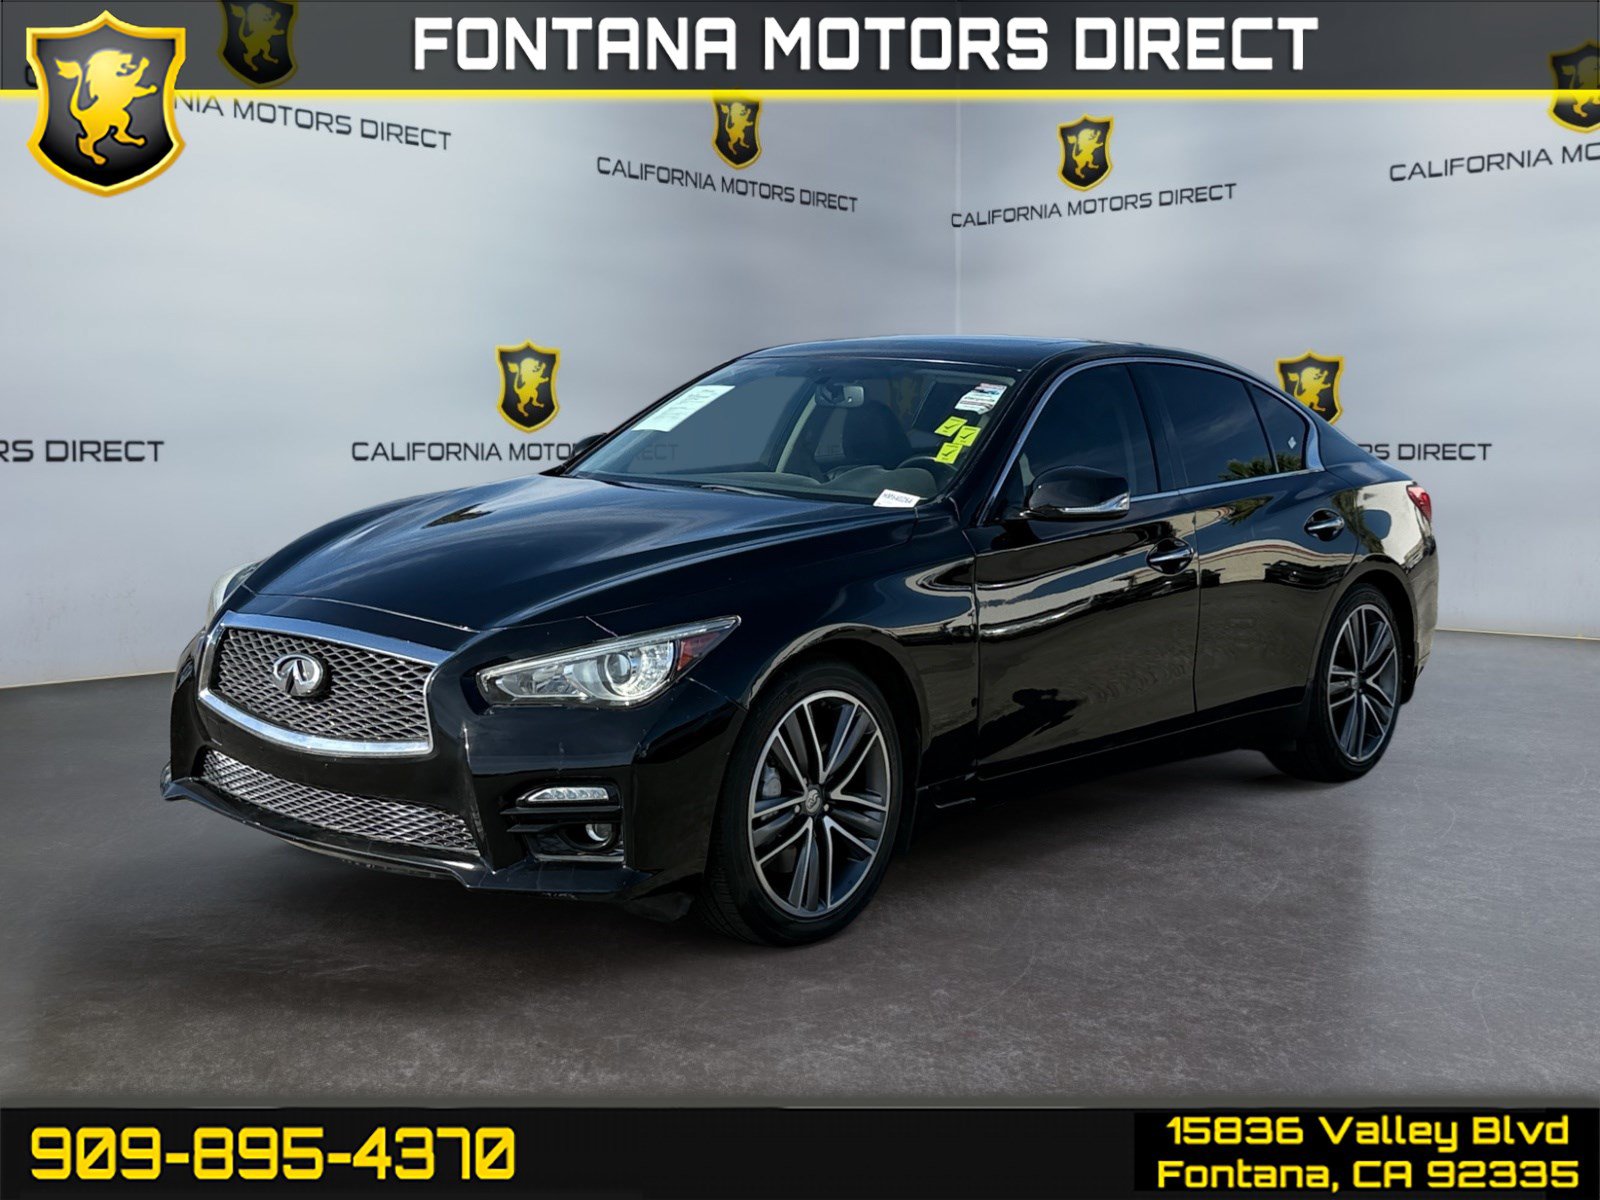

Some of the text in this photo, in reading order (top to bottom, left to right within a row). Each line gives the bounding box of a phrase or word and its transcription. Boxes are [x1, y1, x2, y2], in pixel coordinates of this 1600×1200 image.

[233, 98, 352, 135] MOTORS
[360, 118, 452, 151] DIRECT
[1389, 148, 1554, 182] CALIFORNIA
[596, 156, 859, 213] CALIFORNIA MOTORS DIRECT
[950, 182, 1238, 229] CALIFORNIA MOTORS DIRECT
[45, 439, 165, 463] DIRECT
[351, 441, 504, 461] CALIFORNIA
[509, 442, 577, 461] MOTO
[1397, 443, 1493, 461] DIRECT
